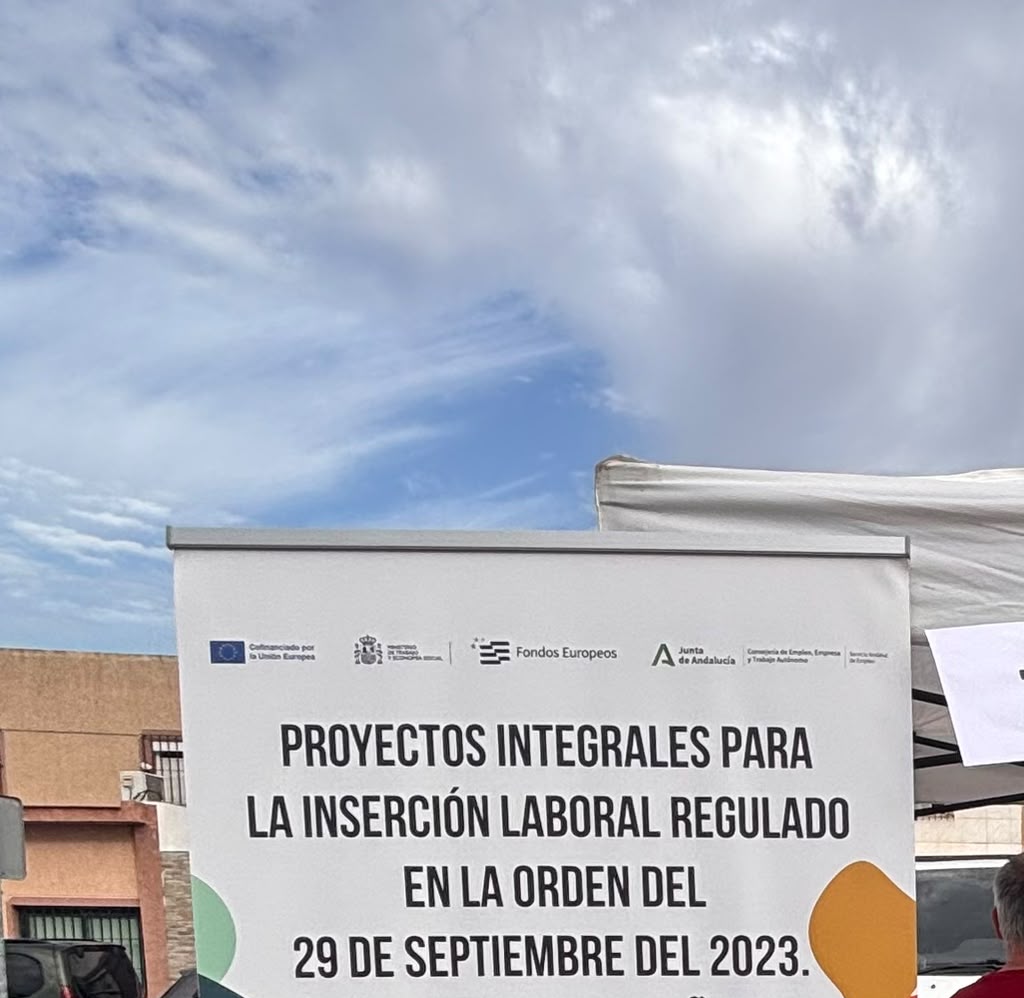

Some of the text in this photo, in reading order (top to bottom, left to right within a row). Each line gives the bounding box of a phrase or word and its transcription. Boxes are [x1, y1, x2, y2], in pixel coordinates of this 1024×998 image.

[249, 643, 315, 653] Cofinanciado por
[516, 646, 618, 661] Fondos Europeos
[678, 646, 704, 655] Junta
[258, 653, 282, 662] Unión
[283, 654, 316, 663] Europea
[678, 655, 736, 666] de Andalucía
[280, 723, 813, 769] PROYECTOS INTEGRALES PARA
[247, 786, 850, 840] LA INSERCIÓN LABORAL REGULADO
[403, 865, 707, 908] EN LA ORDEN DEL
[293, 934, 811, 979] 29 DE SEPTIEMBRE DEL 2023.
